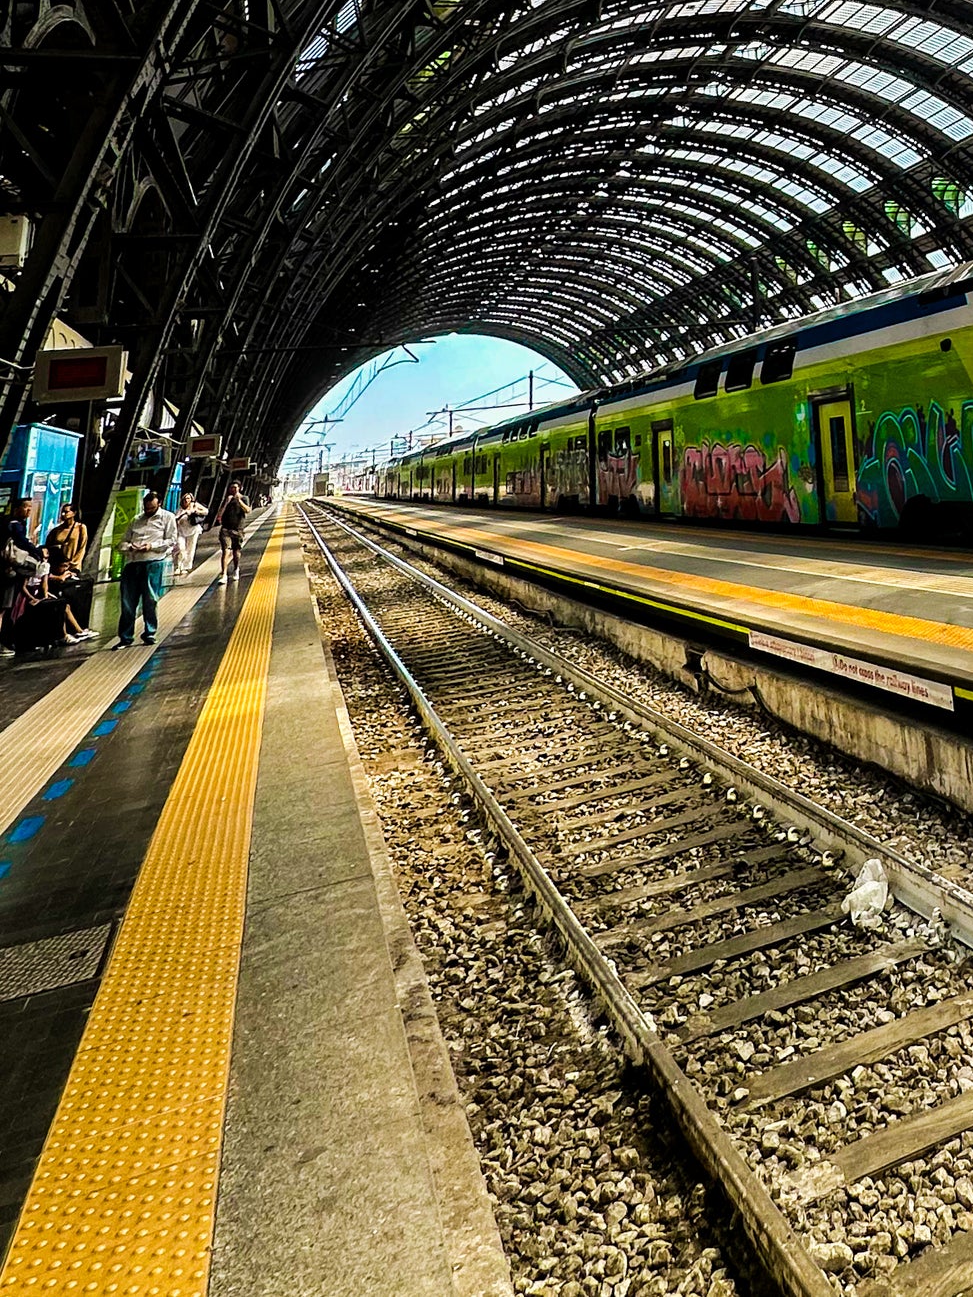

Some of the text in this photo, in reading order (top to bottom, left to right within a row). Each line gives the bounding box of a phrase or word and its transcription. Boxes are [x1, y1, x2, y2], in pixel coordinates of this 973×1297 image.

[848, 664, 858, 675] not
[858, 667, 874, 681] cross
[874, 669, 886, 682] the
[886, 674, 911, 695] railway
[911, 680, 929, 698] lines
